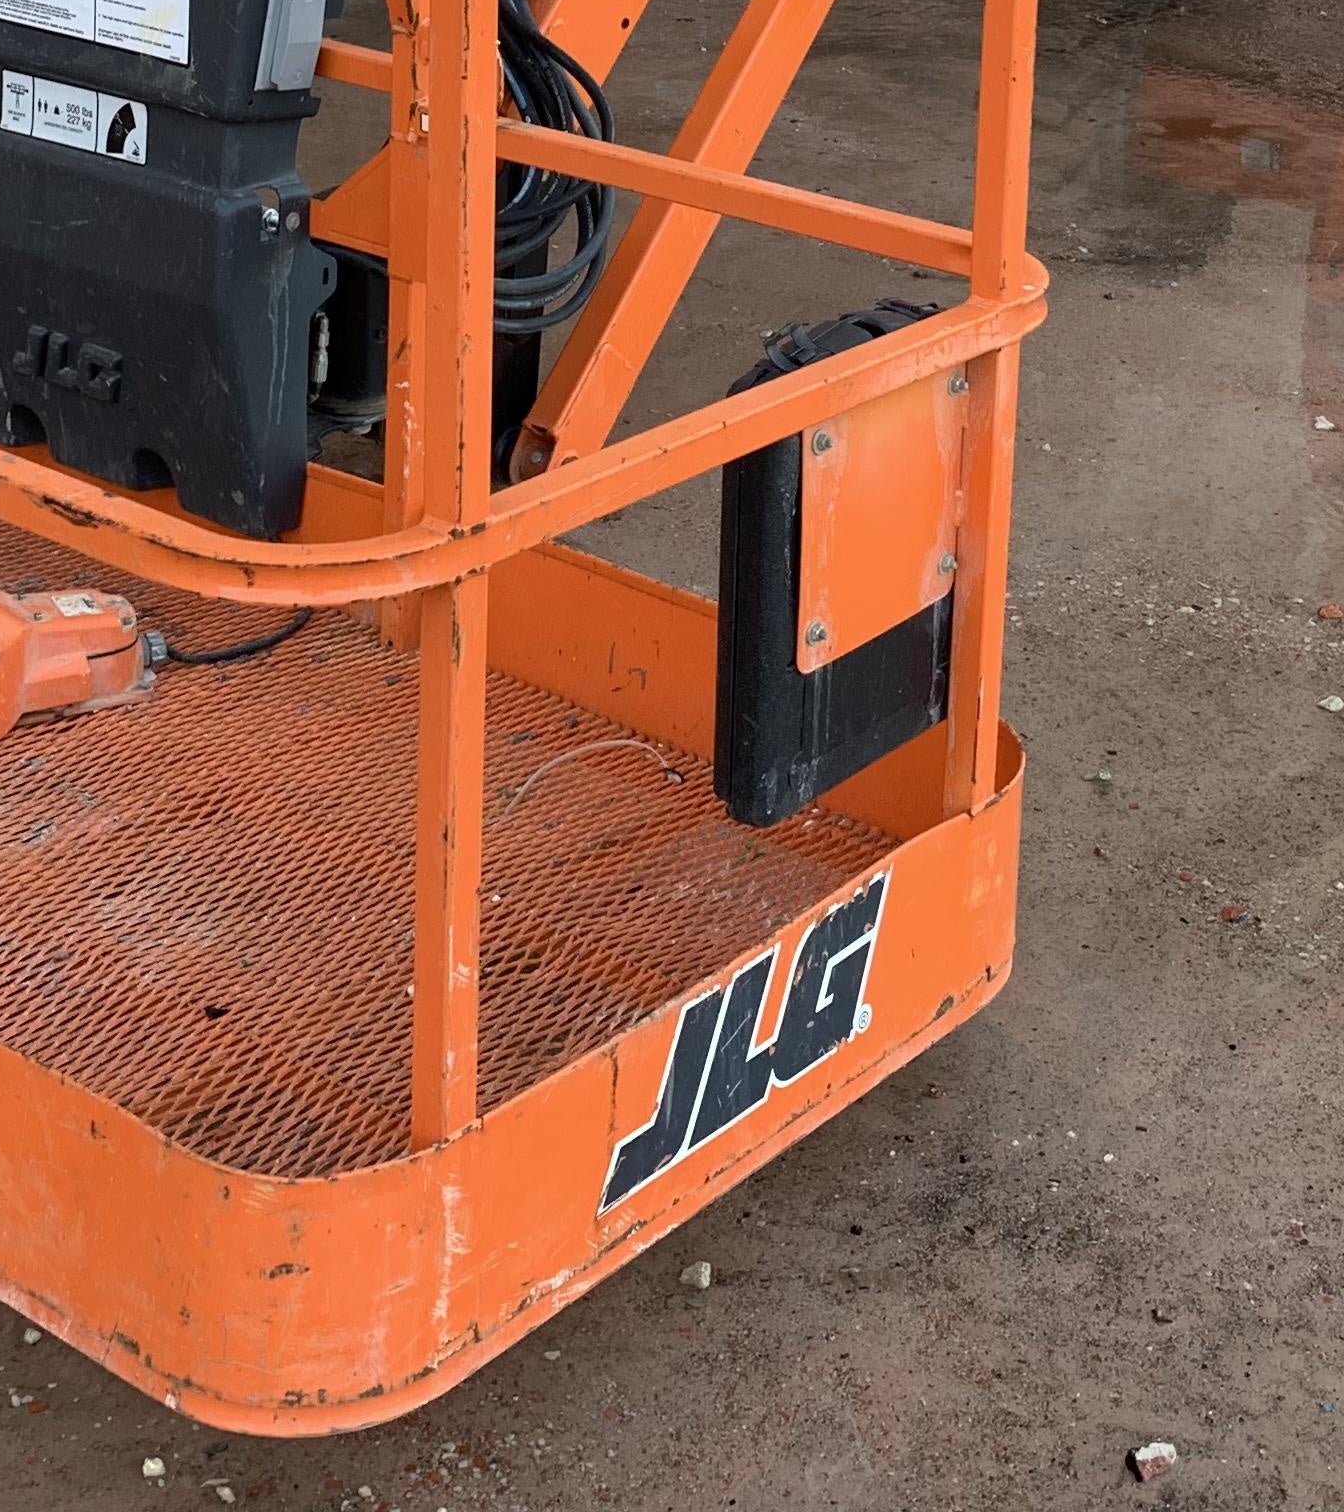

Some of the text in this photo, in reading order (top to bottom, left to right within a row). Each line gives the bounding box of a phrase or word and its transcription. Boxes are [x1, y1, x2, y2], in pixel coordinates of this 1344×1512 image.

[66, 103, 93, 118] 500 lbs
[66, 114, 81, 126] 227
[82, 117, 92, 131] kg
[12, 324, 123, 404] JLG
[595, 863, 894, 1221] JLG
